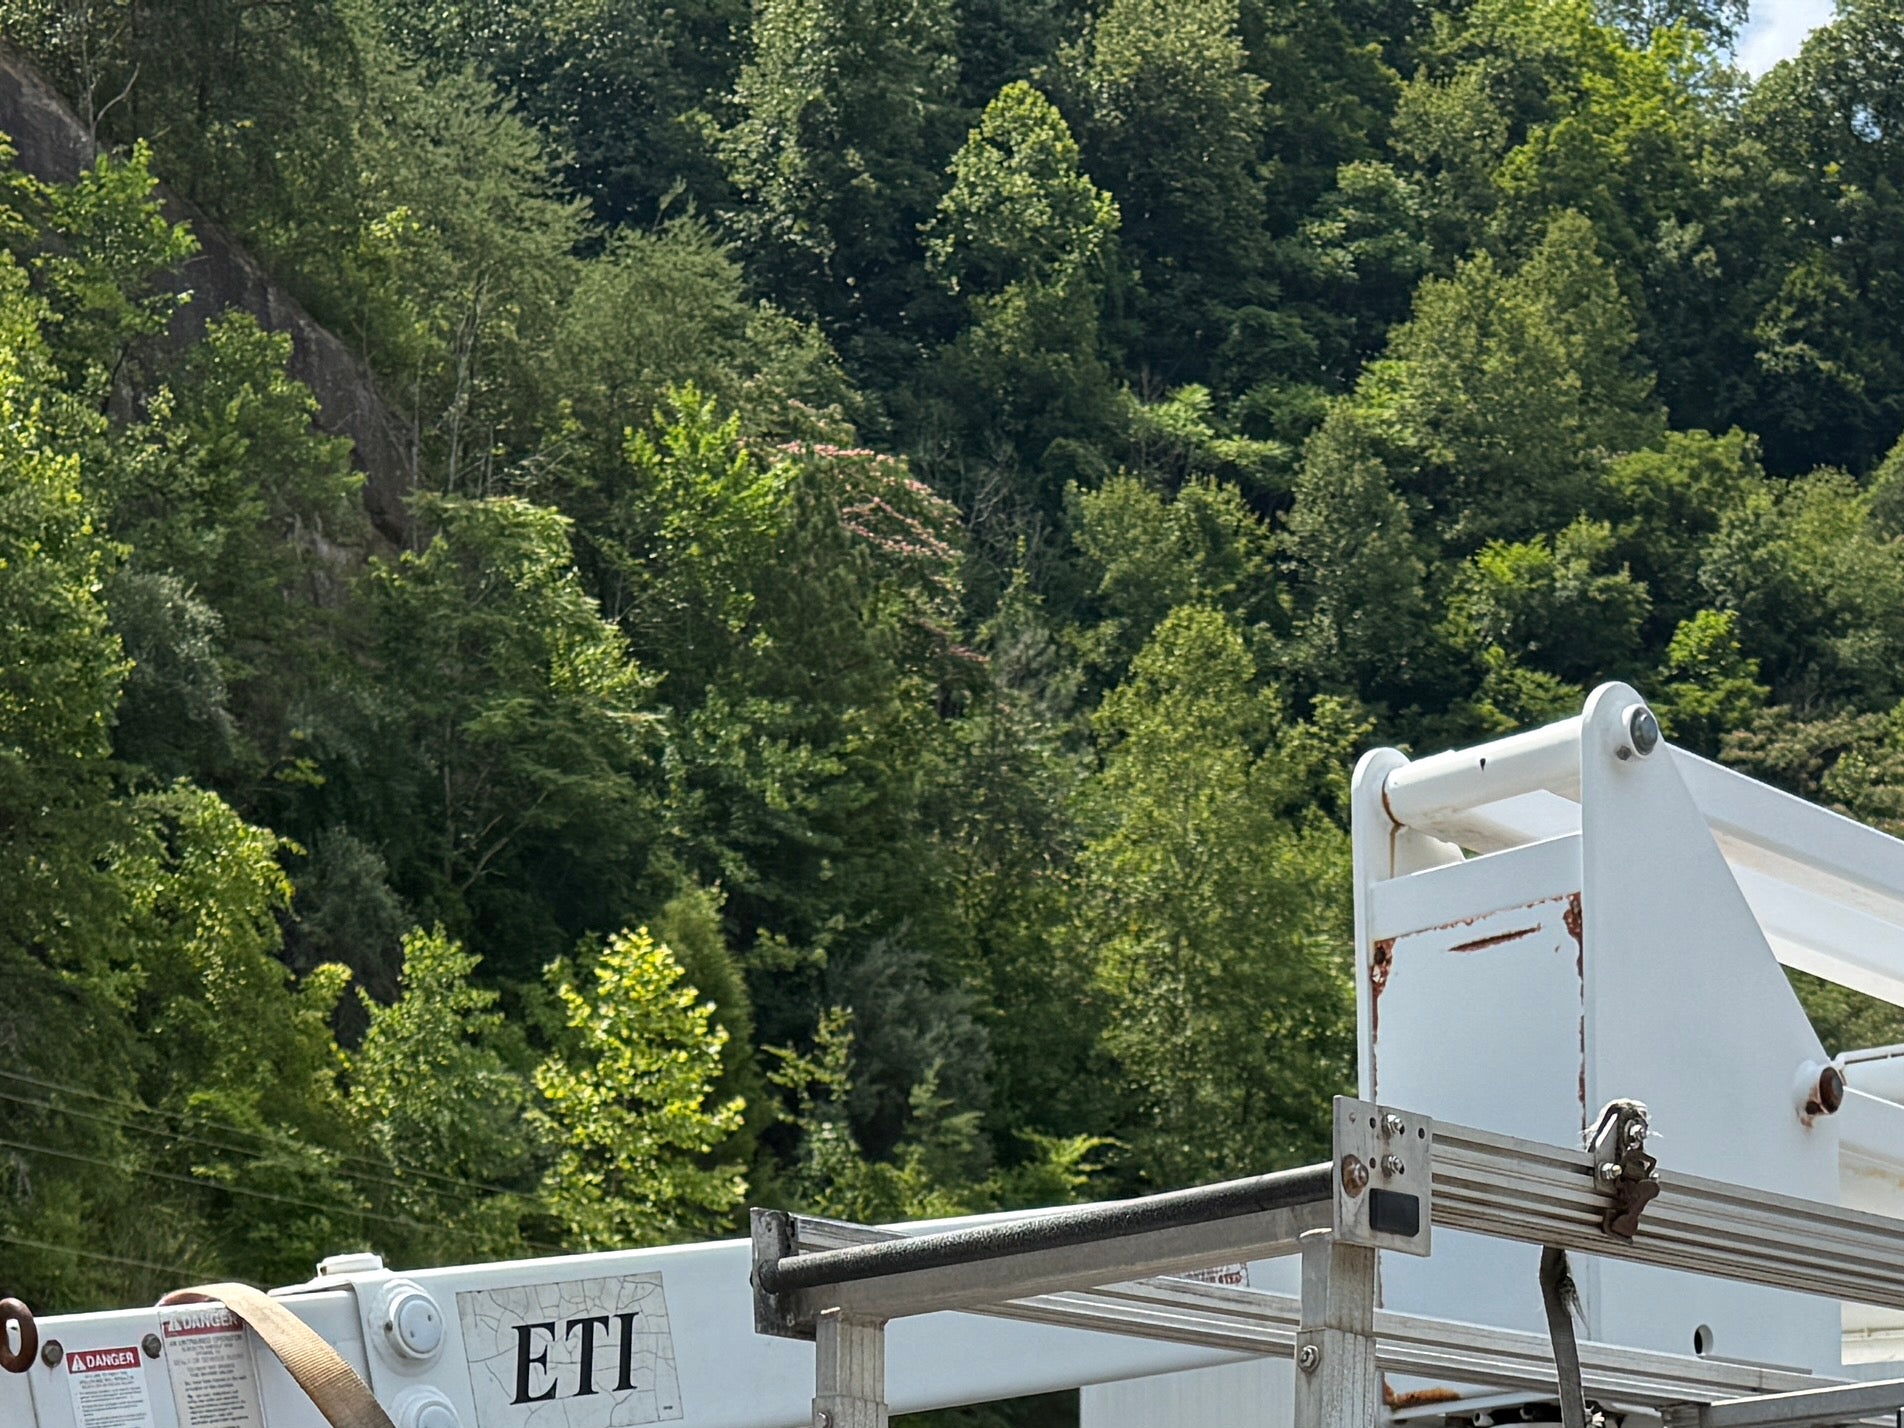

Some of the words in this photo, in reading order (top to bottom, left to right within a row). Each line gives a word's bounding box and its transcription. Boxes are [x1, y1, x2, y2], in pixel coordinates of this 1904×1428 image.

[183, 1309, 239, 1329] DANGER
[85, 1351, 135, 1369] DANGER
[509, 1311, 640, 1406] ETI
